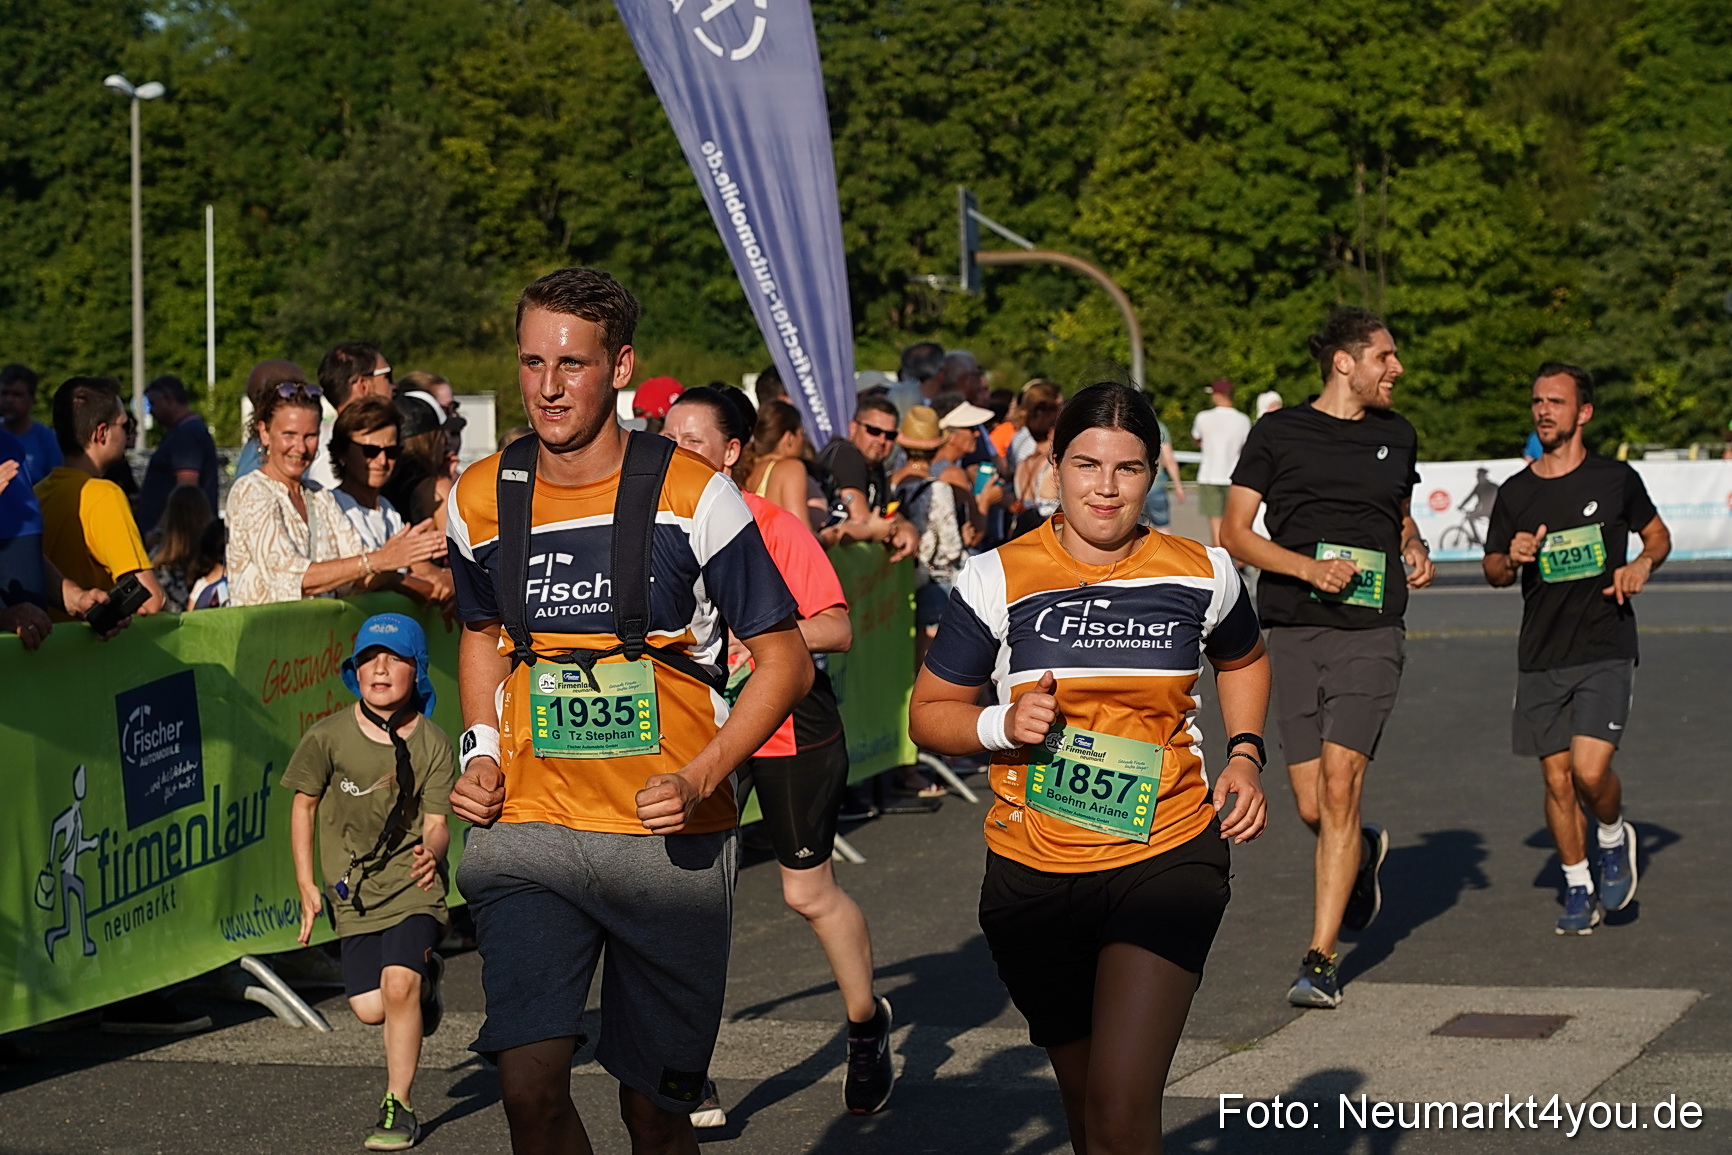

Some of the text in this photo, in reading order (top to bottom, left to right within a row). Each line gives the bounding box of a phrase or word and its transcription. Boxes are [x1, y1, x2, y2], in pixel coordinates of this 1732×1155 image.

[1548, 544, 1592, 566] 1291
[526, 573, 654, 604] Fisch
[534, 602, 614, 619] AUTOMO
[1060, 616, 1180, 637] Fischer
[1071, 638, 1173, 649] AUTOMOBILE
[262, 629, 344, 704] Gesunde
[536, 705, 548, 738] RUN
[550, 696, 635, 727] 1935
[638, 698, 652, 741] 2022
[133, 720, 184, 756] Fischer
[569, 731, 582, 741] Tz
[585, 729, 635, 742] Stephan
[139, 743, 181, 768] AUTOMOBILE
[1065, 744, 1107, 759] Firmenlauf
[1032, 762, 1047, 793] RUN
[1051, 757, 1139, 804] 1857
[1046, 788, 1086, 810] Boehm
[1089, 802, 1129, 820] Ariane
[1133, 782, 1152, 827] 2022
[98, 761, 273, 909] firmenlauf
[104, 884, 177, 942] neumarkt
